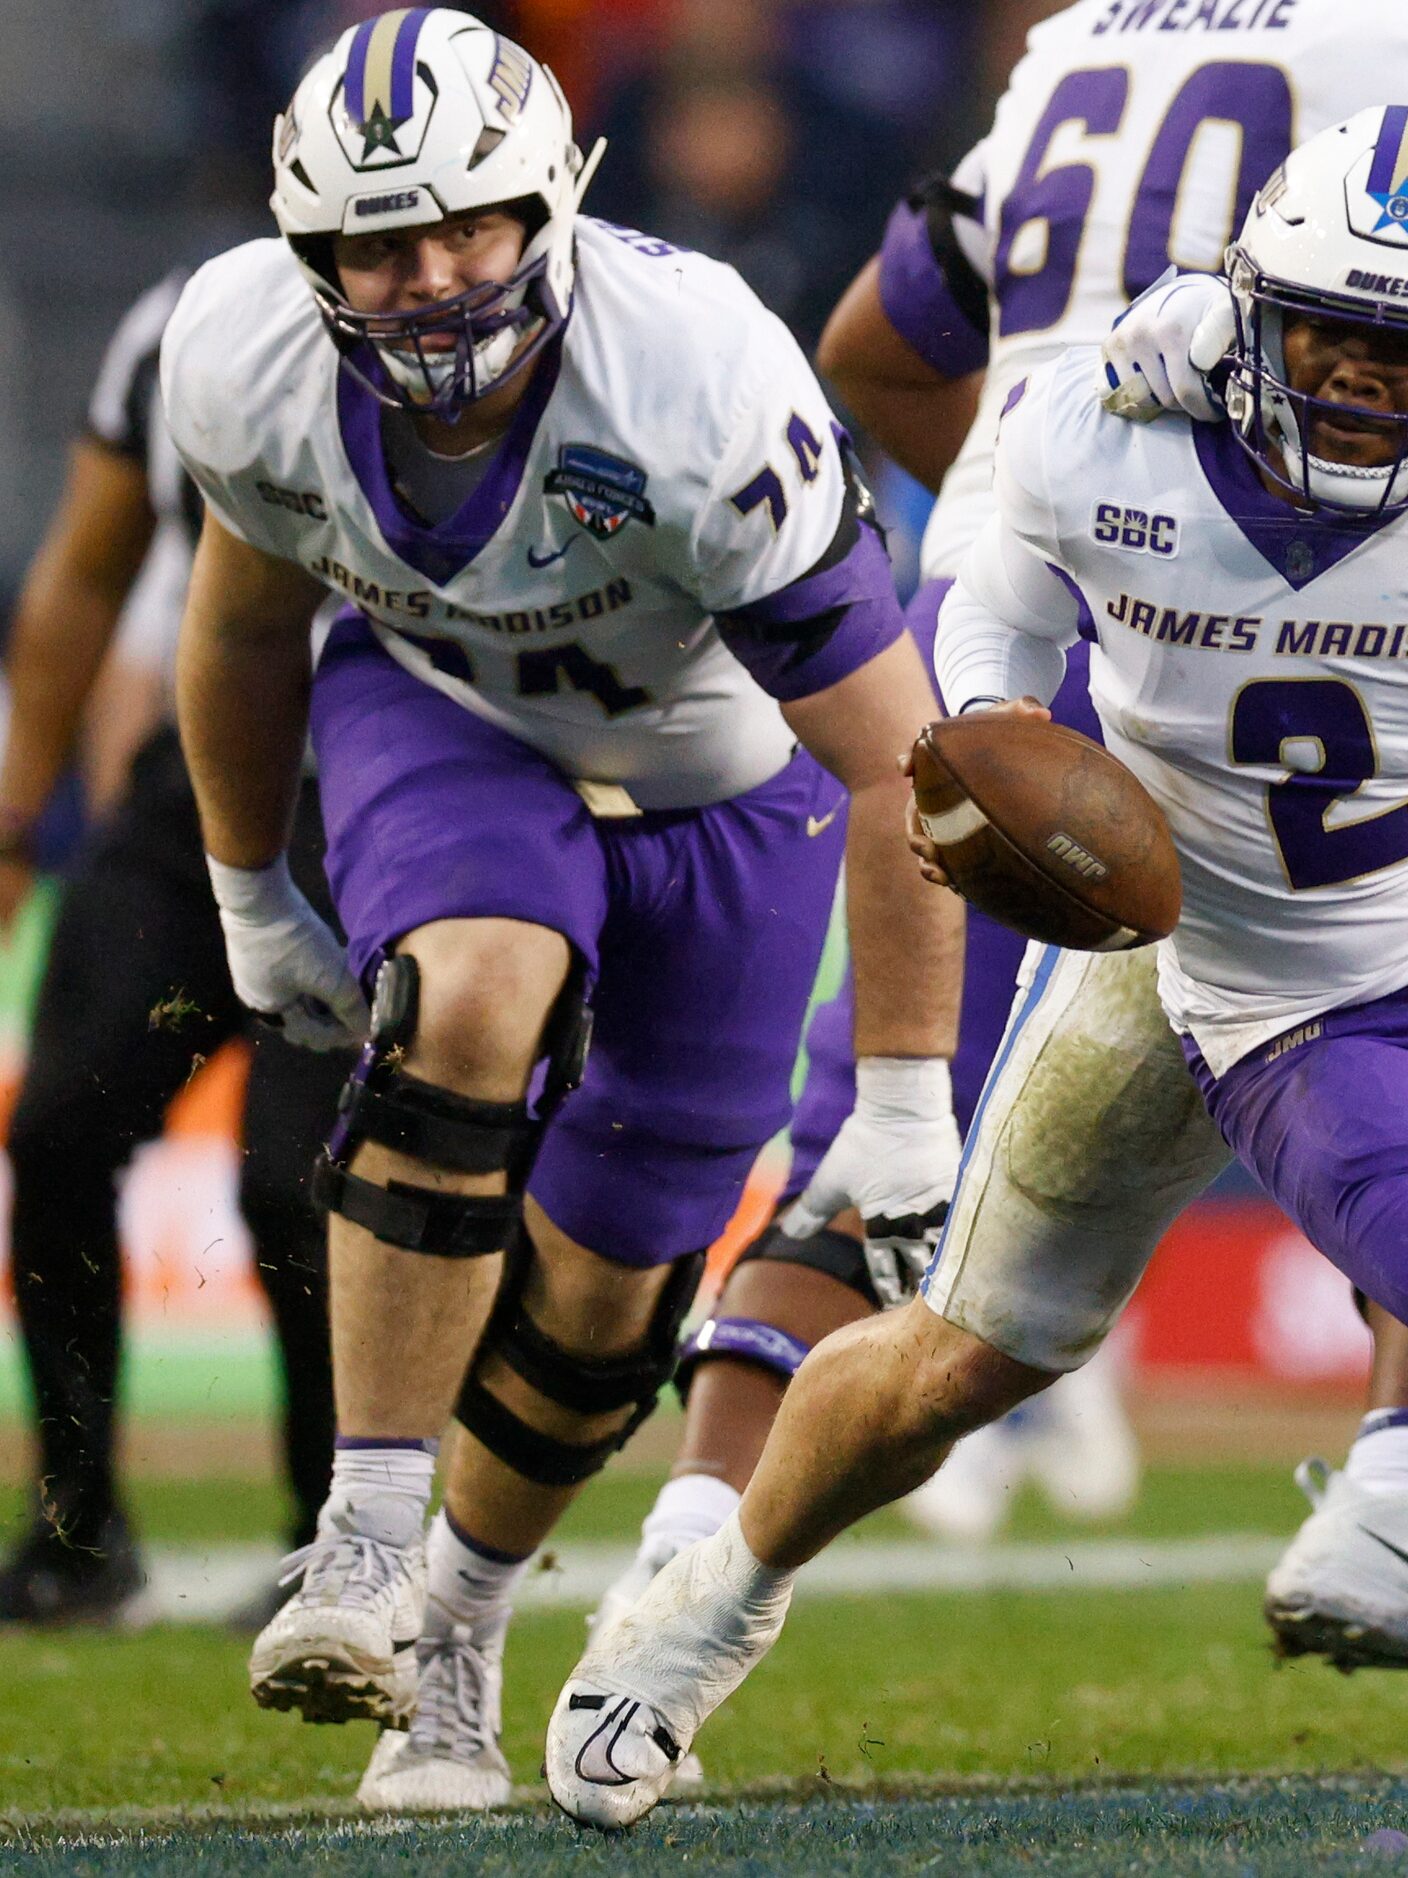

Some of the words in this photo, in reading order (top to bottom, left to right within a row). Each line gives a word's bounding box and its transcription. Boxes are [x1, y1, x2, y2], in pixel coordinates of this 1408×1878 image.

[487, 31, 533, 127] JM
[992, 58, 1300, 343] 60
[722, 406, 824, 544] 74
[1094, 503, 1176, 554] SBC
[311, 554, 434, 619] JAMES
[1106, 592, 1265, 655] JAMES
[1265, 1018, 1322, 1064] JMU
